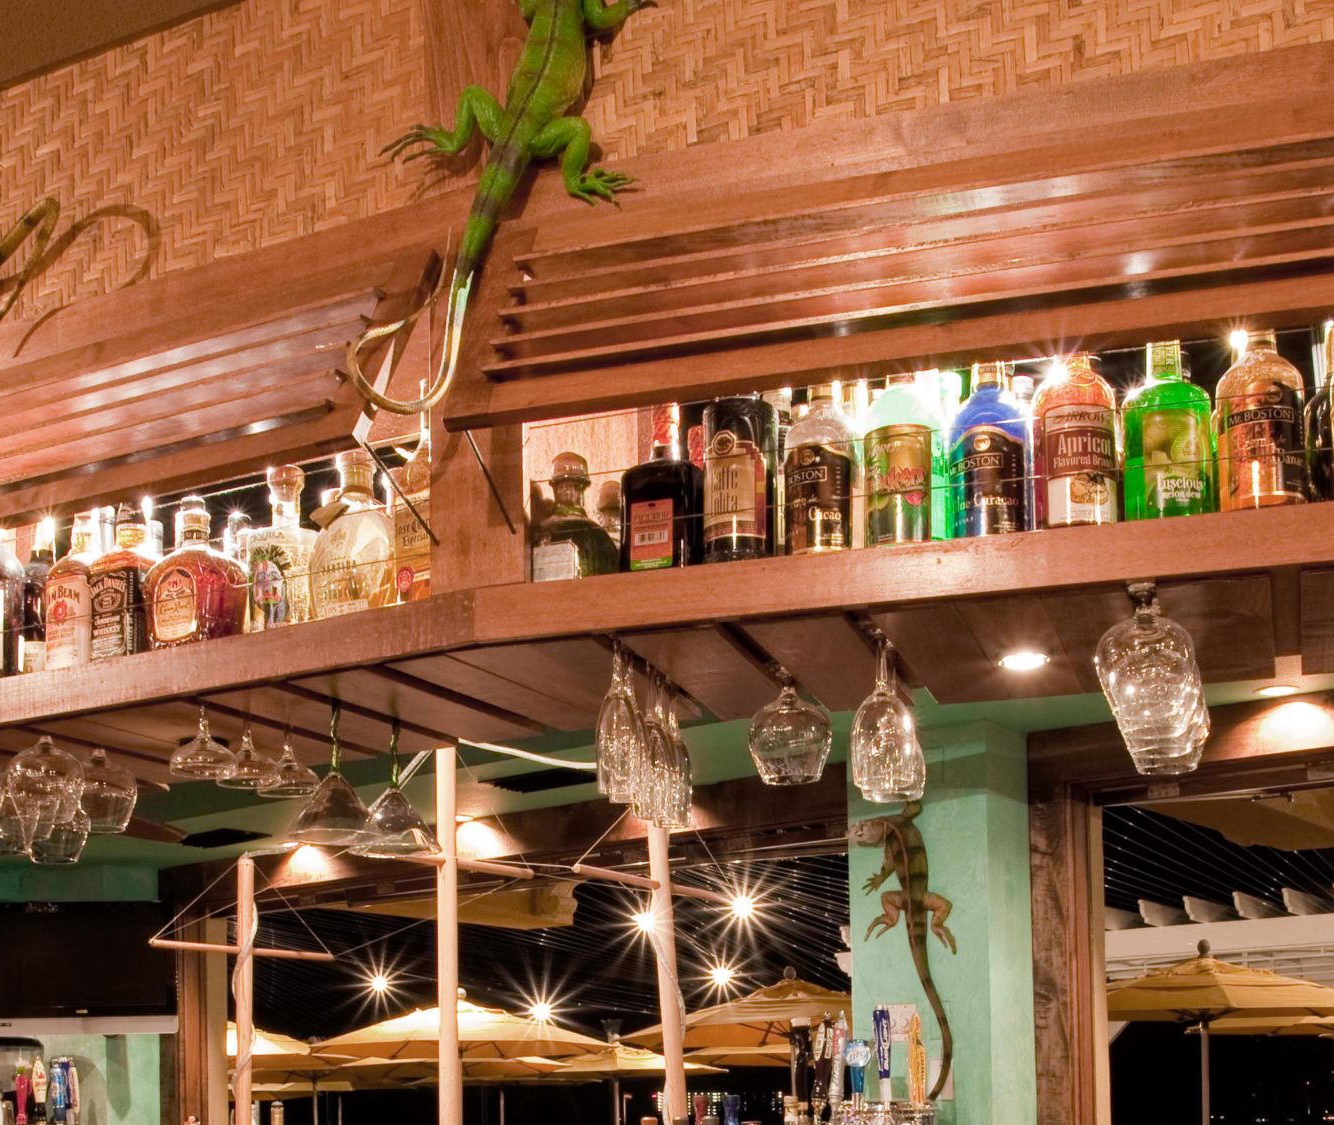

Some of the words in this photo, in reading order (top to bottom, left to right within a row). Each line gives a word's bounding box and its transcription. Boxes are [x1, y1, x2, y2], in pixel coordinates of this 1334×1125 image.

[1244, 407, 1292, 420] BOSTON
[957, 455, 1000, 474] BOSTON
[1053, 453, 1091, 469] Flavored
[1156, 474, 1205, 493] Luscious
[57, 584, 80, 604] BEAM
